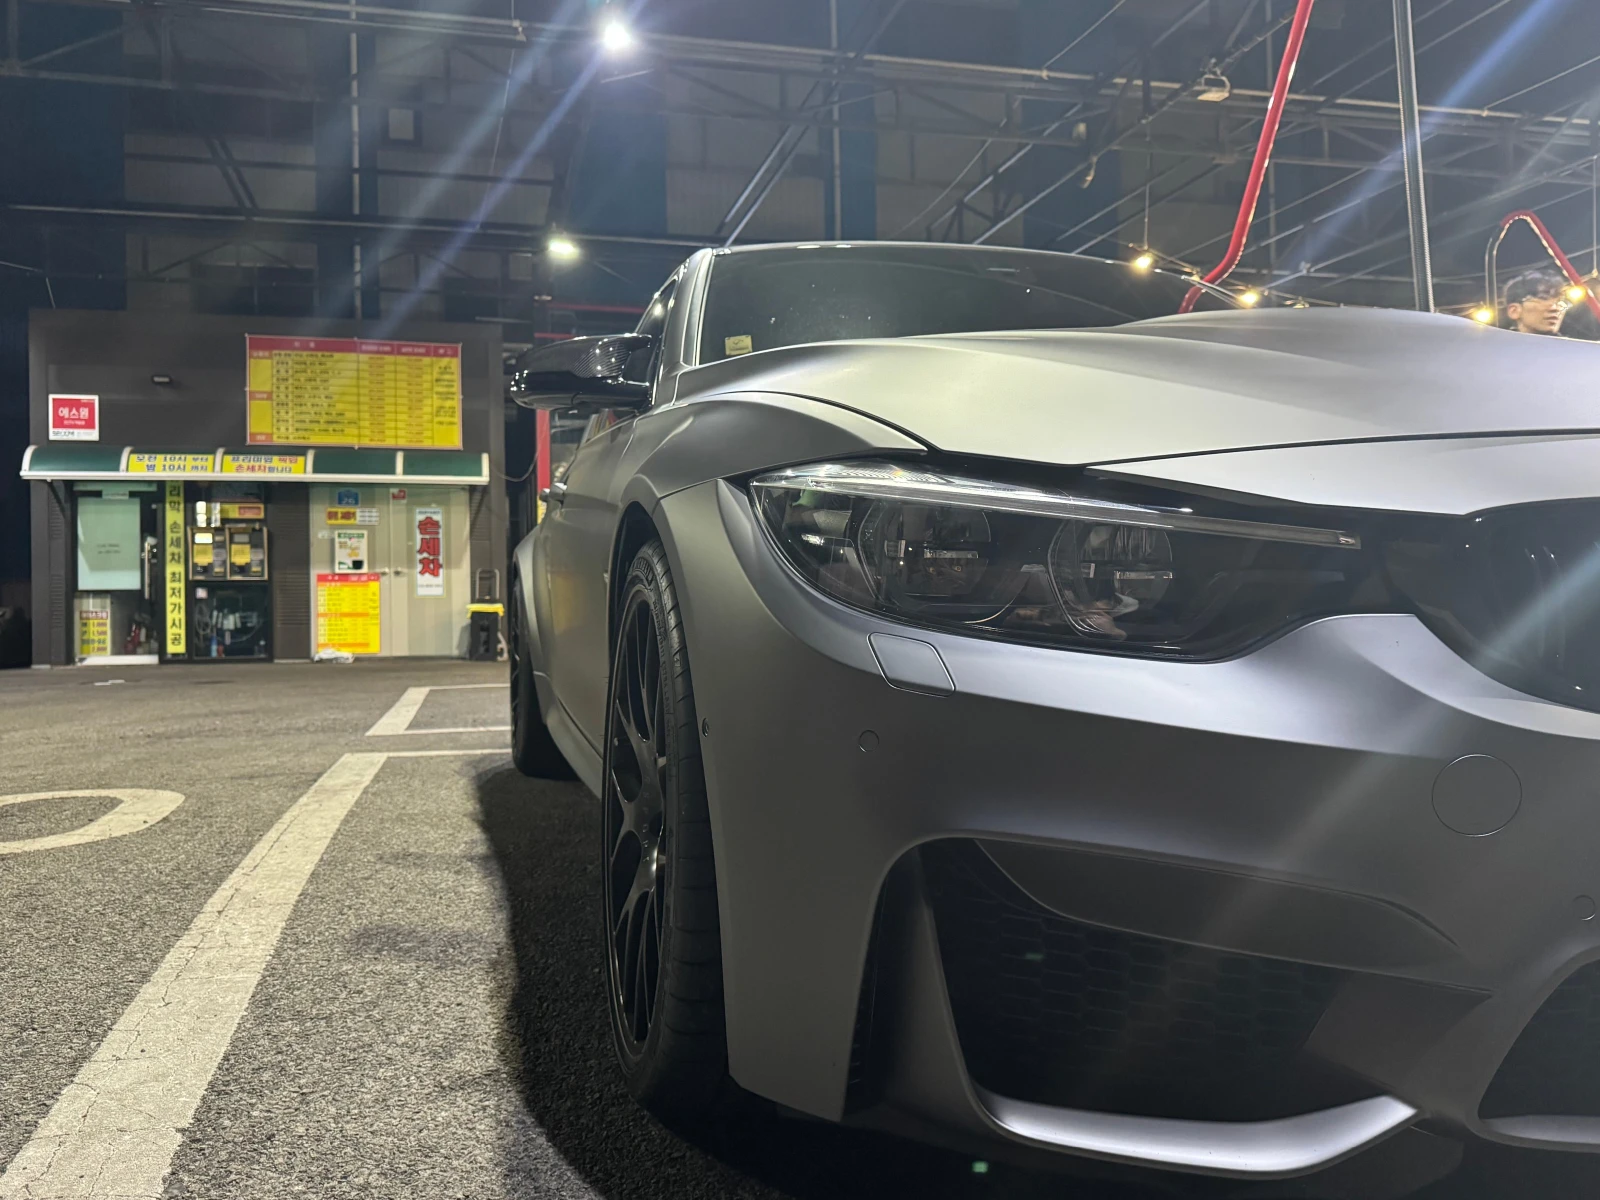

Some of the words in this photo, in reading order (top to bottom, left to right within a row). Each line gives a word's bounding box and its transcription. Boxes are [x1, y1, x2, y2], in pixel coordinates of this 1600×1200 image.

[58, 406, 89, 420] 에스원
[163, 454, 187, 462] 10시
[231, 455, 273, 464] 프리미엄
[162, 463, 187, 472] 10시
[169, 520, 182, 565] 손세차
[418, 516, 443, 577] 손세차
